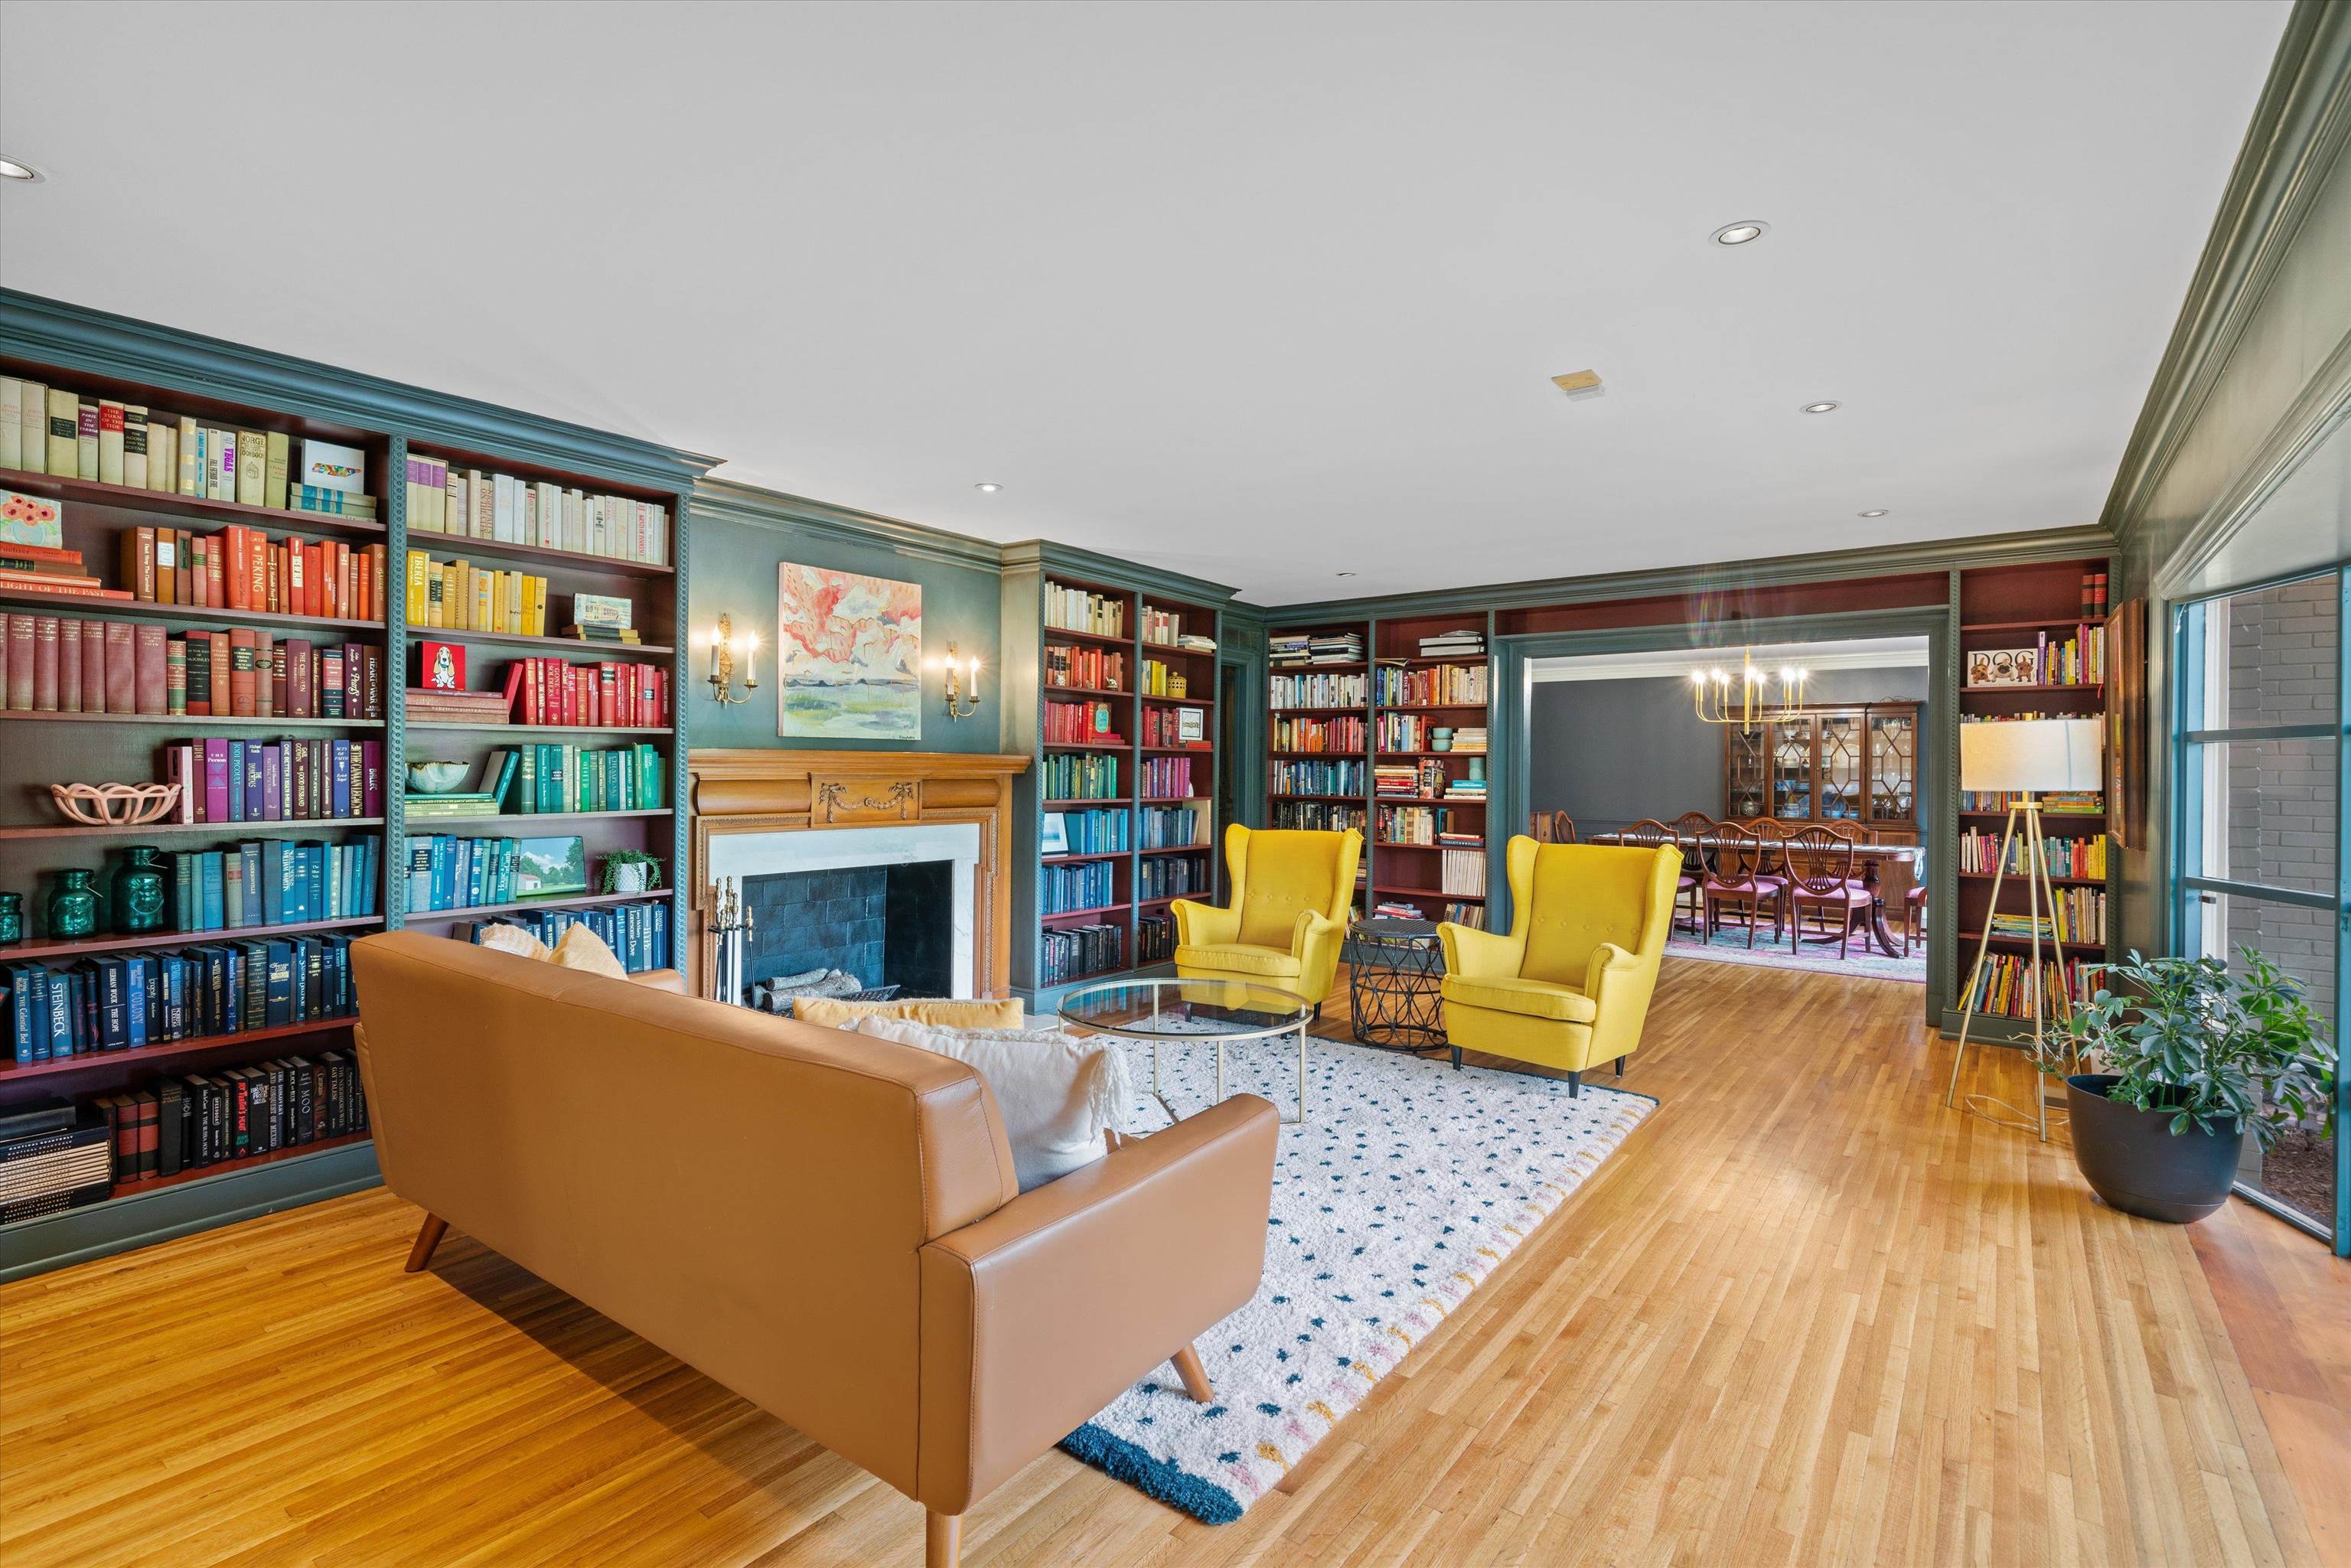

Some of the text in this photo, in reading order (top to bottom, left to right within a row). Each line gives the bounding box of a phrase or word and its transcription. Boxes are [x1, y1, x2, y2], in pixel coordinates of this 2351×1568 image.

[223, 448, 233, 473] VEGAS
[253, 554, 264, 592] PEKING
[415, 556, 423, 585] IBERIA
[38, 584, 53, 592] OF
[55, 585, 79, 595] THE
[82, 588, 105, 597] PAST
[370, 657, 378, 681] HEART
[351, 751, 362, 810] THE CANAAN LEGACY
[497, 872, 506, 892] House
[51, 983, 66, 1038] STEINBECK
[132, 992, 144, 1025] COLONY
[20, 1033, 28, 1044] Bed
[238, 1082, 246, 1090] MY
[302, 1090, 310, 1113] MOO
[8, 1136, 73, 1151] NAUTICAL QUARTERLY
